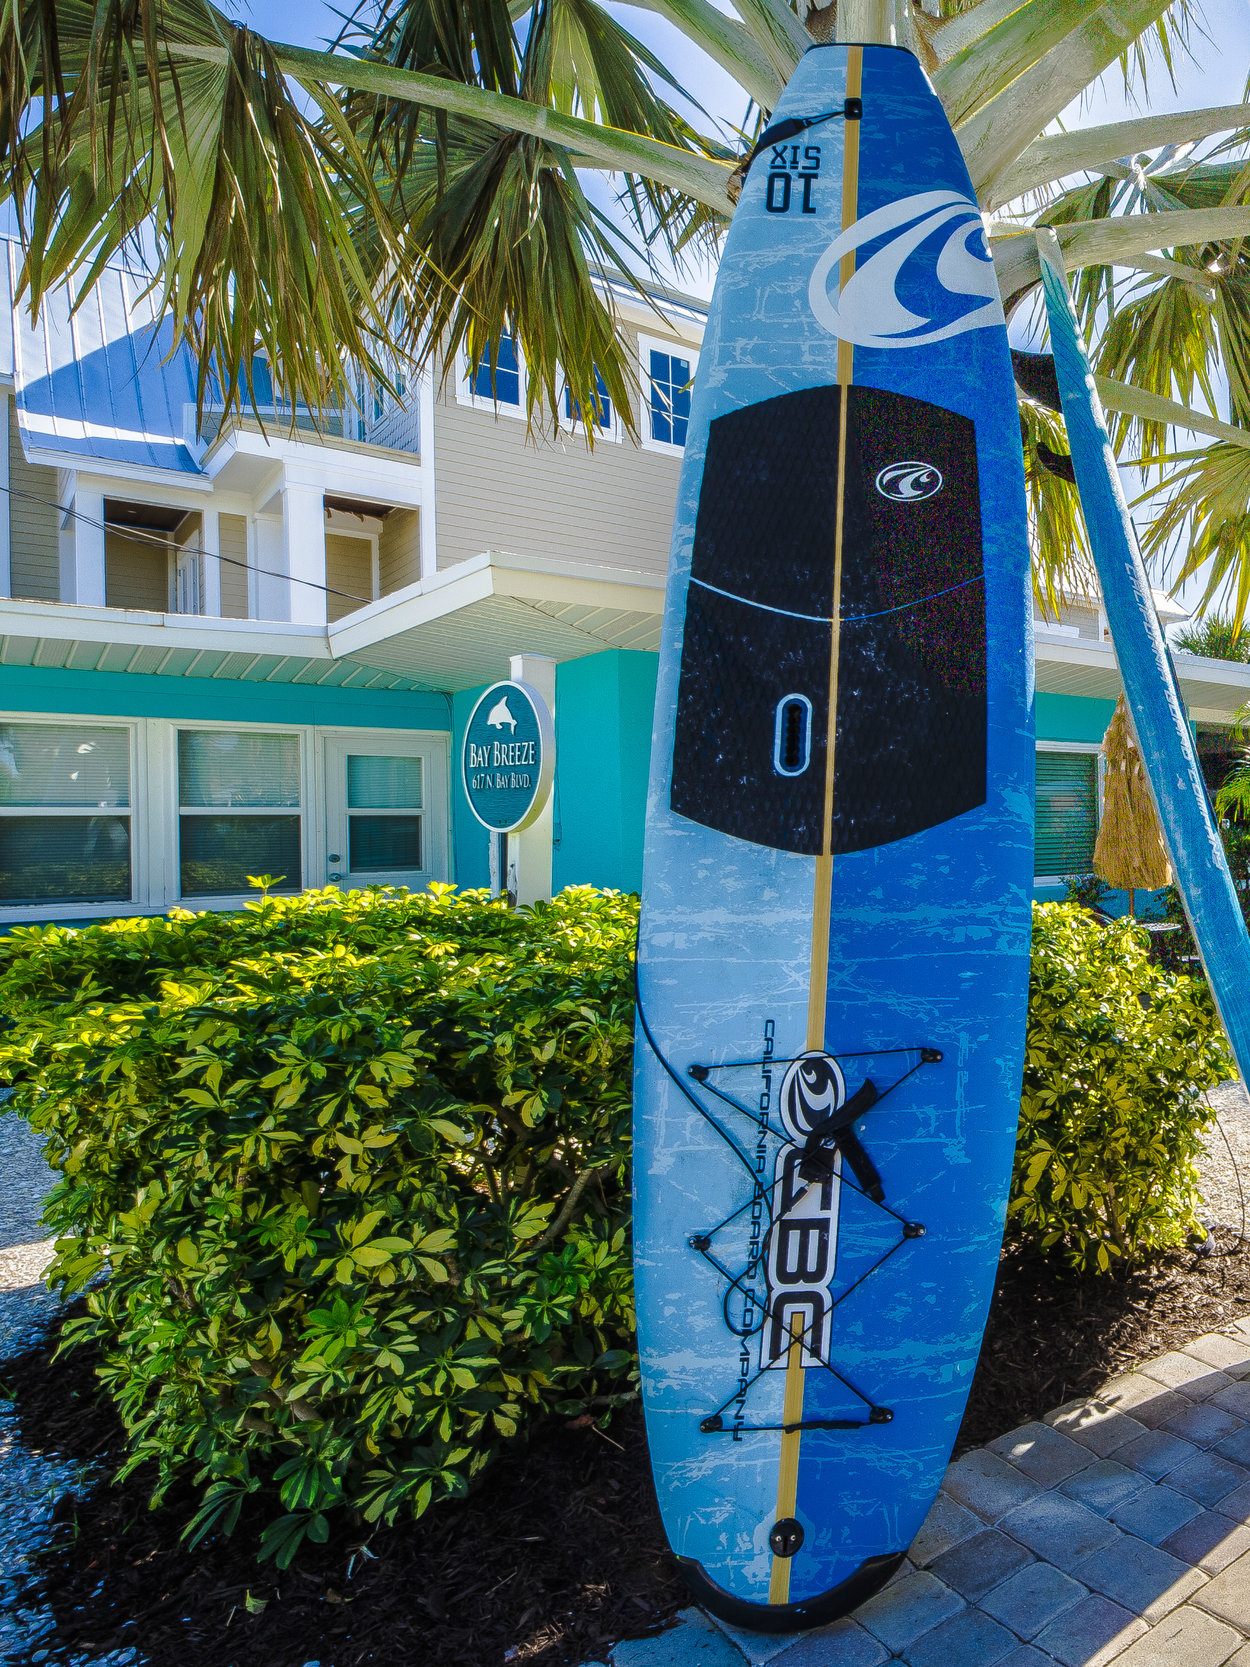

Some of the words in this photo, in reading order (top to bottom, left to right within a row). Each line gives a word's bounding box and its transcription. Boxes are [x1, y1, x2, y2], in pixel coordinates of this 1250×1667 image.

[770, 145, 821, 170] SIX
[766, 172, 818, 213] 10
[469, 743, 491, 768] BAY
[493, 741, 536, 766] BREEZE
[472, 773, 485, 789] 617
[486, 774, 495, 789] N.
[496, 773, 511, 789] BAY
[511, 772, 532, 788] BLVD.
[754, 1019, 775, 1174] CALIFORNIA
[744, 1179, 762, 1280] BOARD
[732, 1288, 754, 1443] COMPANY
